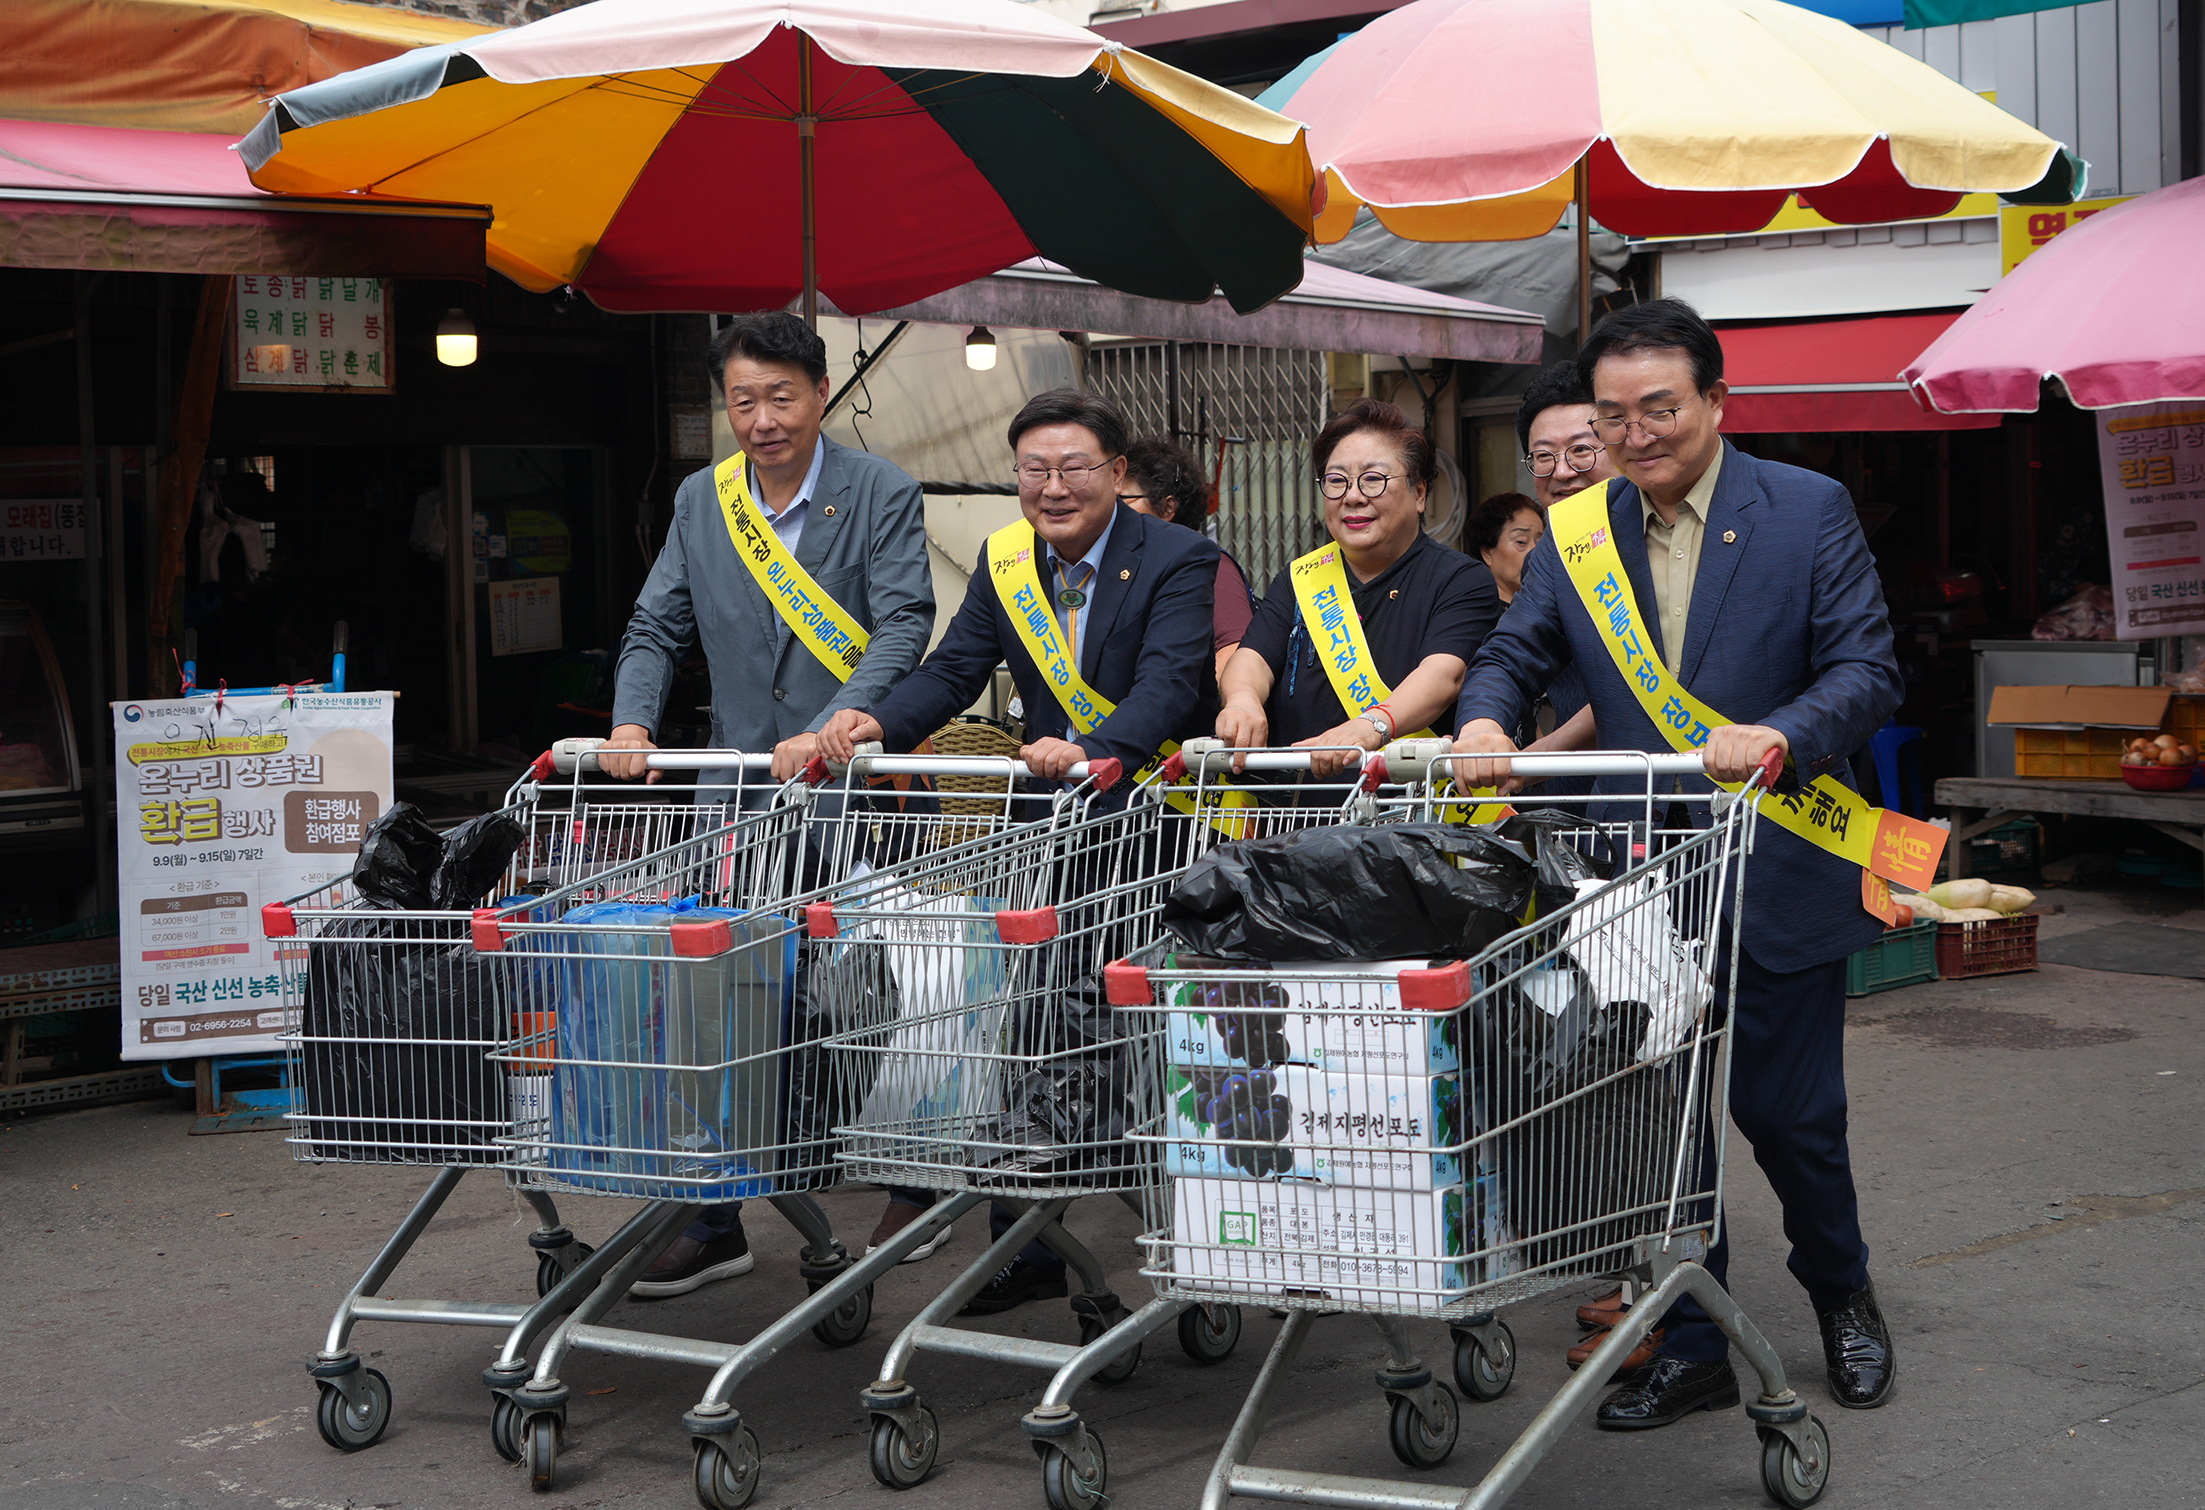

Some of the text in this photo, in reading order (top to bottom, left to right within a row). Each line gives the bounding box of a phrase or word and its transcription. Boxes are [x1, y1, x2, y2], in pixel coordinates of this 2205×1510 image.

[243, 309, 308, 336] 육계닭
[244, 347, 381, 376] 삼계닭 닭훈제
[2116, 429, 2178, 455] 온누리
[2119, 455, 2175, 490] 환급
[730, 493, 771, 562] 전통시장
[0, 535, 71, 557] 합니다.
[2126, 580, 2199, 601] 당일 국산 신선
[1013, 583, 1070, 686] 전통시장
[1593, 571, 1660, 693] 전통시장
[1312, 584, 1380, 714] 전통시장 장
[148, 707, 205, 718] 농림축산식품부
[302, 697, 382, 706] 한국농수산식품유통공사
[138, 754, 323, 796] 온누리 상품권
[139, 796, 276, 846] 환급 행사
[304, 799, 361, 821] 환급행사
[305, 823, 361, 845] 참여점포
[152, 853, 187, 867] 9.9(월)
[198, 850, 236, 864] 9.15(일)
[238, 848, 263, 861] 7일간
[177, 880, 212, 893] 환급 기준
[308, 872, 325, 883] 본인
[167, 901, 181, 910] 기준
[151, 910, 236, 926] 34,000원 이상 1만원
[152, 926, 237, 942] 67,000원 이상 2만원
[138, 984, 171, 1008] 당일
[175, 980, 207, 1004] 국산
[211, 977, 243, 1001] 신선
[190, 1018, 251, 1032] 02-6956-2254
[1179, 1038, 1204, 1055] 4kg
[1181, 1146, 1206, 1164] 4kg
[1227, 1220, 1248, 1229] GAP
